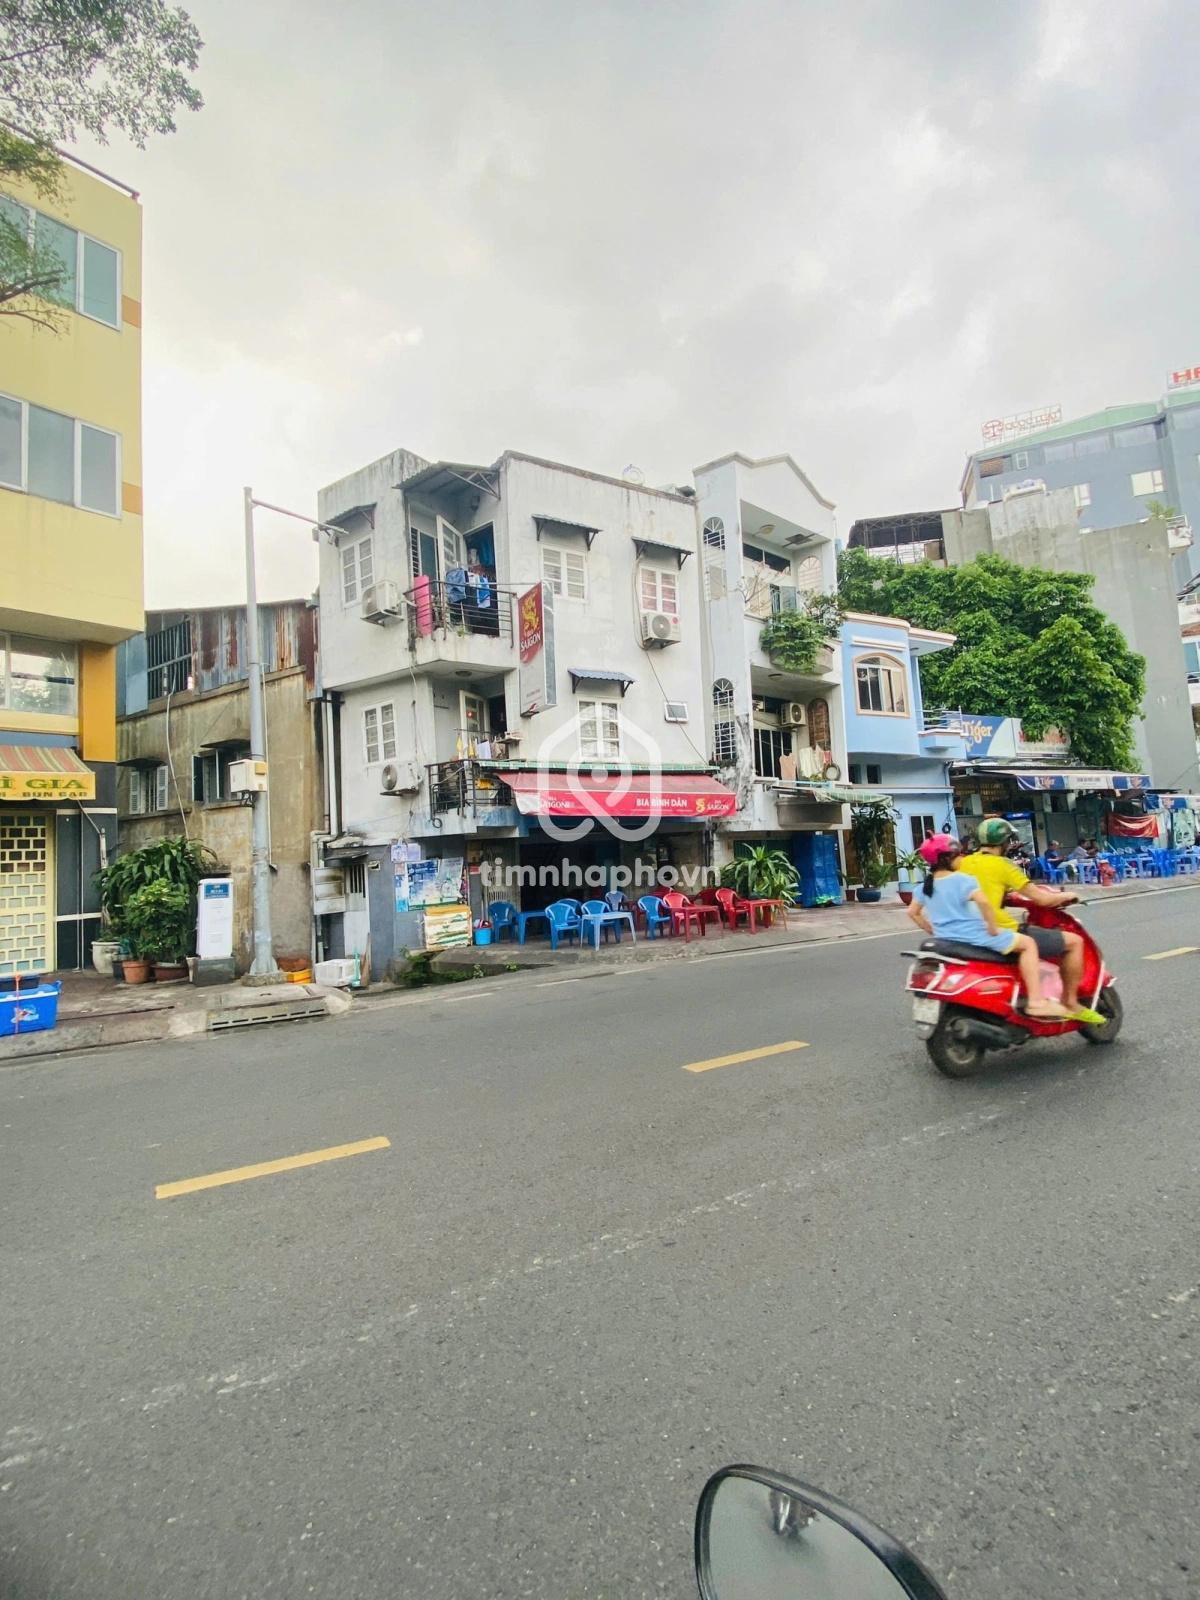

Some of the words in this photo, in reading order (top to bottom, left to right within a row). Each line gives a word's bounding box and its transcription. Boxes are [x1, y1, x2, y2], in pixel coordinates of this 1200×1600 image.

[521, 631, 541, 653] SAIGON
[963, 719, 993, 744] Tiger
[25, 778, 86, 789] GIA
[636, 798, 649, 807] BIA
[671, 797, 688, 808] DÂN
[706, 803, 729, 811] SAIGON
